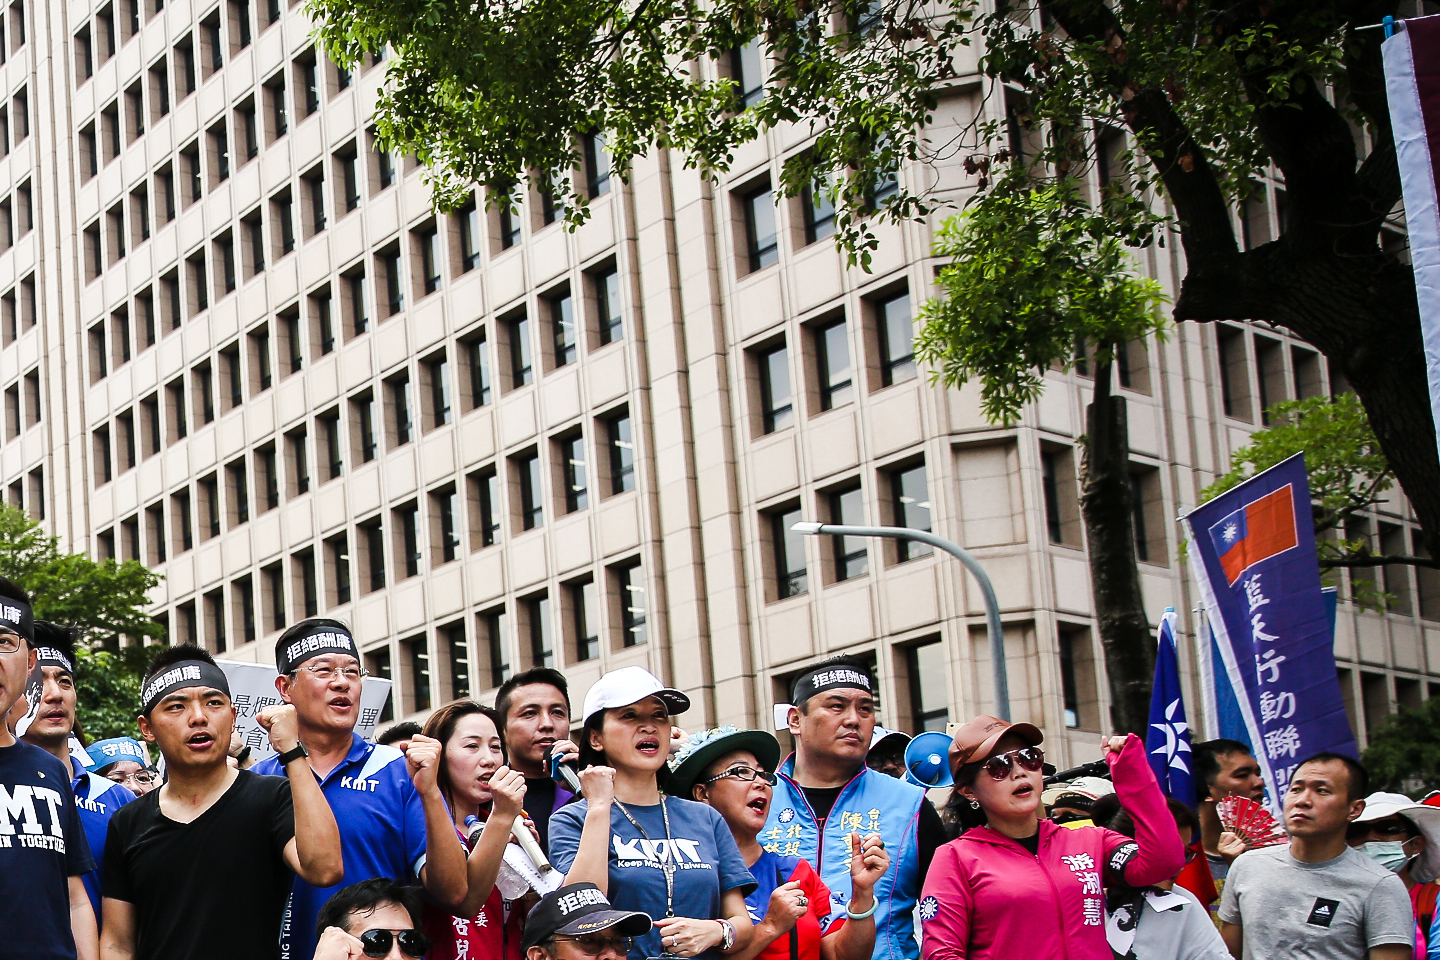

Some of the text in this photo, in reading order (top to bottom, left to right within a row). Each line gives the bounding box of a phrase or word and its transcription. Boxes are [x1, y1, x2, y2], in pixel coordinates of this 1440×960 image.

[287, 632, 353, 663] 拒絕酬庸
[812, 669, 872, 691] 拒絕酬庸
[233, 694, 286, 719] 最爛
[340, 776, 380, 792] KMT
[75, 795, 107, 815] KMT
[612, 833, 702, 863] KMT
[617, 859, 643, 869] Keep
[677, 861, 712, 871] Taiwan
